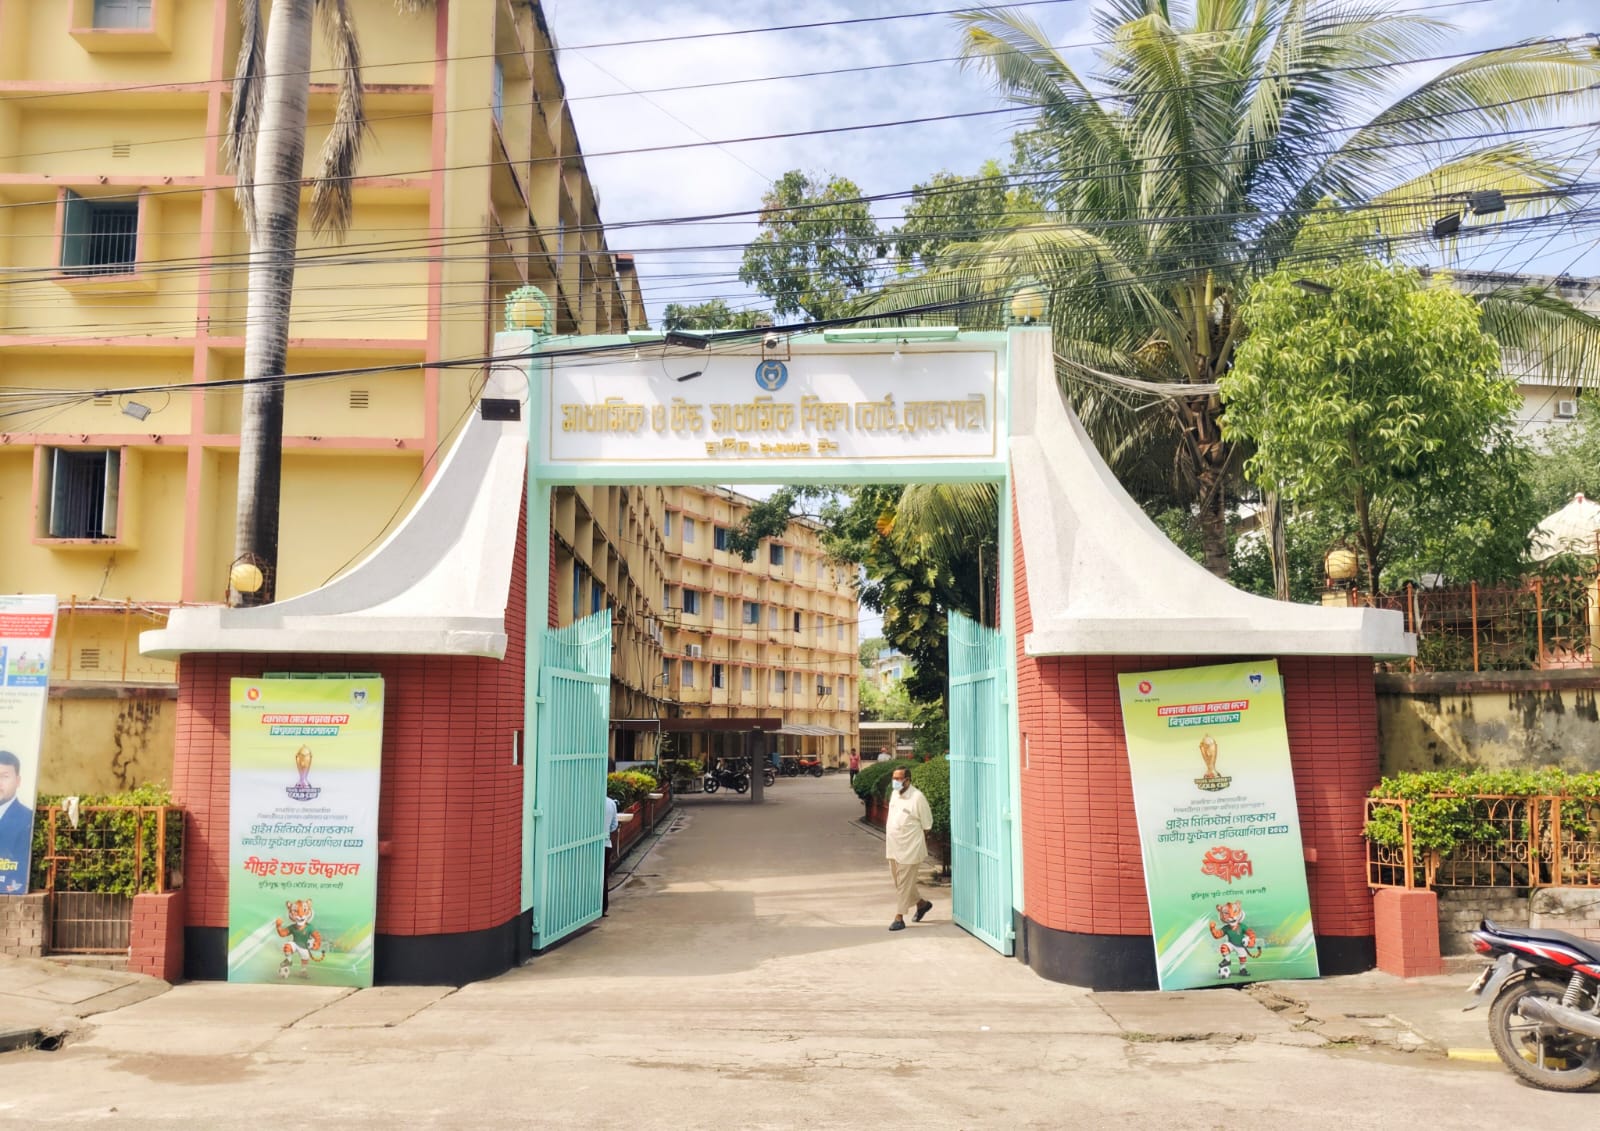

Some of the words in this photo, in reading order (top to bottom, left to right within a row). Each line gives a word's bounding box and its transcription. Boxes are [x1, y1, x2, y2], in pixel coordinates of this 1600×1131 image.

[561, 396, 645, 433] মাধ্যমিক
[651, 404, 666, 433] ও
[671, 397, 704, 433] উচ্চ
[709, 396, 794, 433] মাধ্যমিক
[800, 395, 849, 432] শিক্ষা
[1187, 830, 1217, 844] ফুটবল
[1218, 826, 1266, 840] প্রতিযোগিতা
[1205, 846, 1248, 864] শুভ
[243, 856, 279, 876] শীঘ্রই
[280, 861, 307, 875] শুভ
[308, 858, 360, 878] উদ্বোধন
